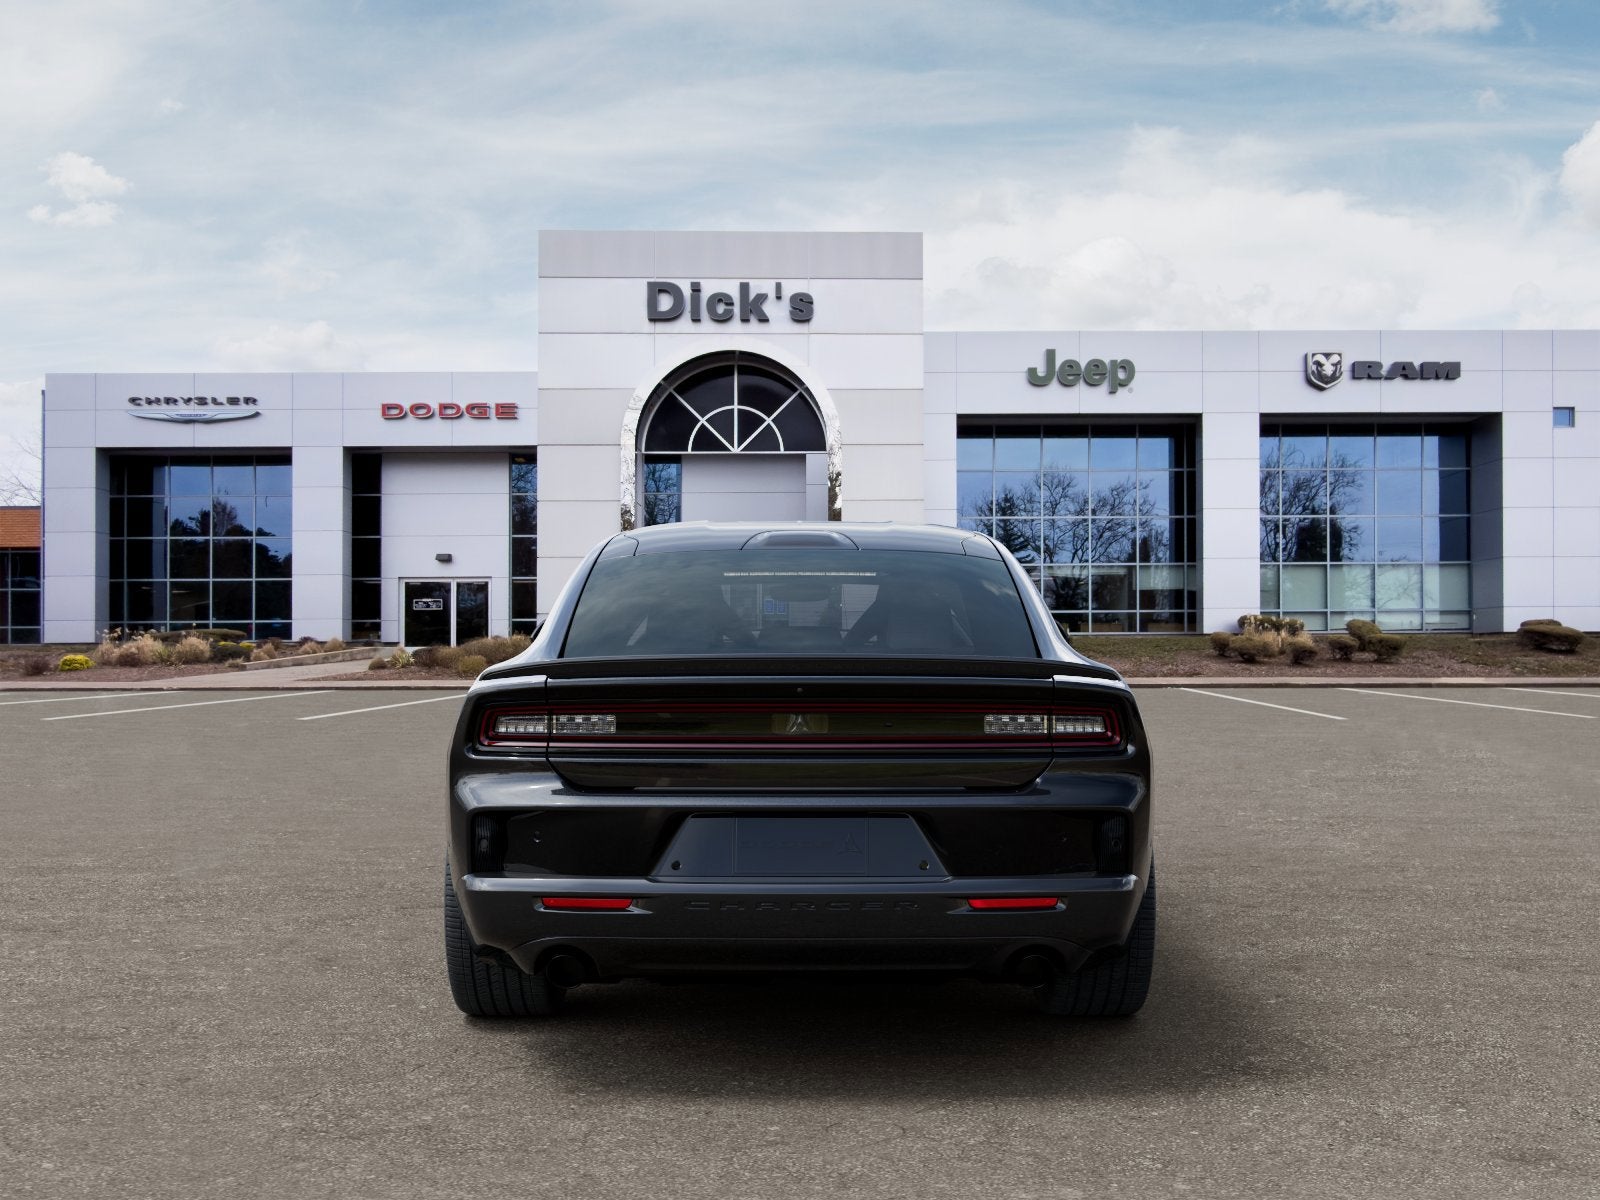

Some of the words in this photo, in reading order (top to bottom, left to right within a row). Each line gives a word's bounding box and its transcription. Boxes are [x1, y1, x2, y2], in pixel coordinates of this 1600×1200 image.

[647, 281, 814, 322] Dick's
[1027, 348, 1136, 394] Jeep
[1352, 361, 1461, 380] RAM
[127, 396, 258, 406] CHRYSLER
[381, 402, 519, 419] DODGE
[684, 900, 921, 911] CHARGER
